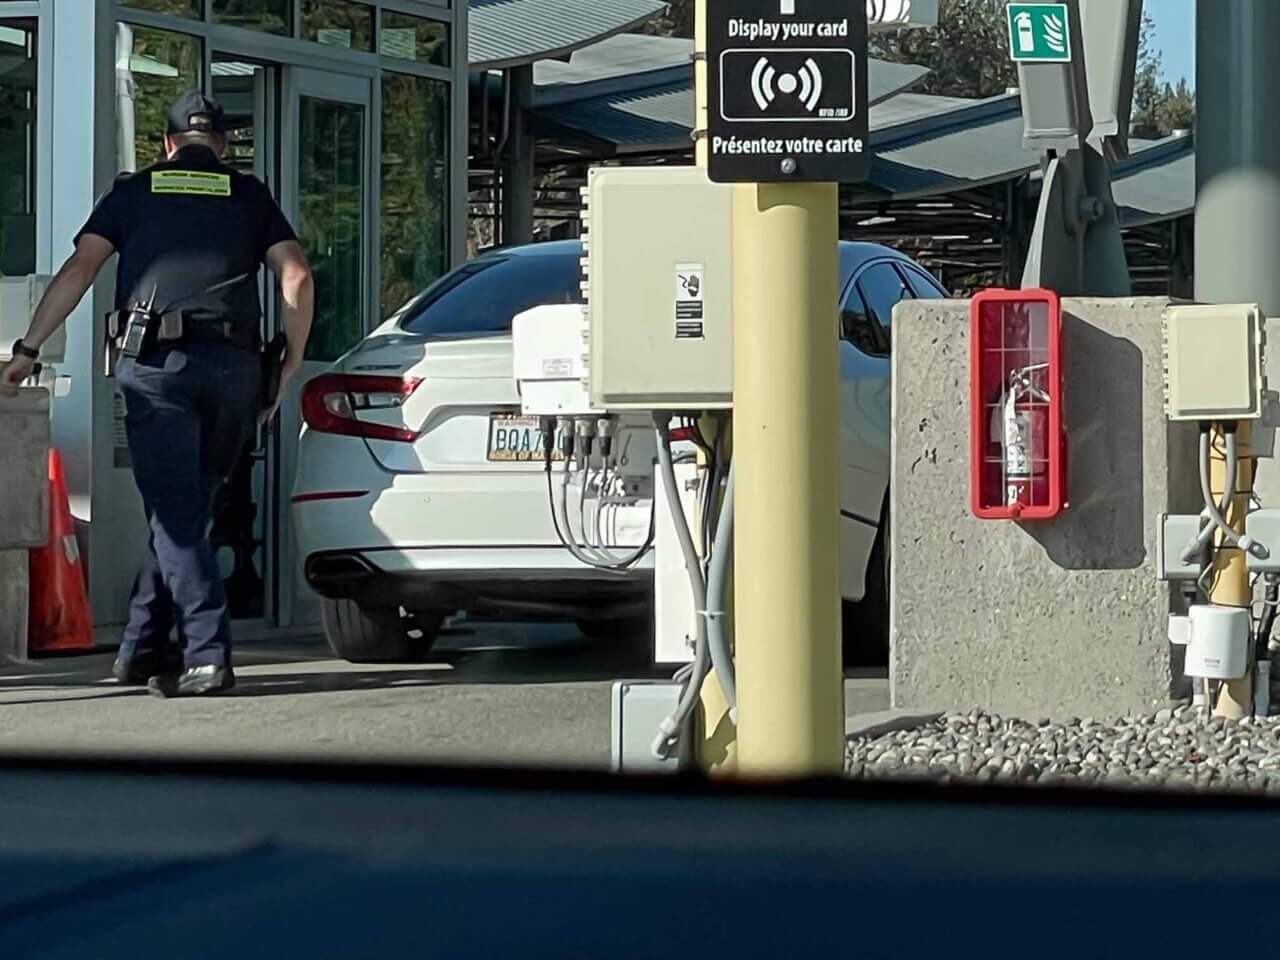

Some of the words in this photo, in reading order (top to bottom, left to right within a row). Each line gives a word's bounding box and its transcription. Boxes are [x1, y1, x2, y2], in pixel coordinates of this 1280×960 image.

[728, 18, 780, 41] Display
[782, 22, 815, 41] your
[816, 18, 848, 37] card
[712, 135, 783, 154] Présentez
[785, 136, 824, 153] votre
[825, 136, 863, 153] carte
